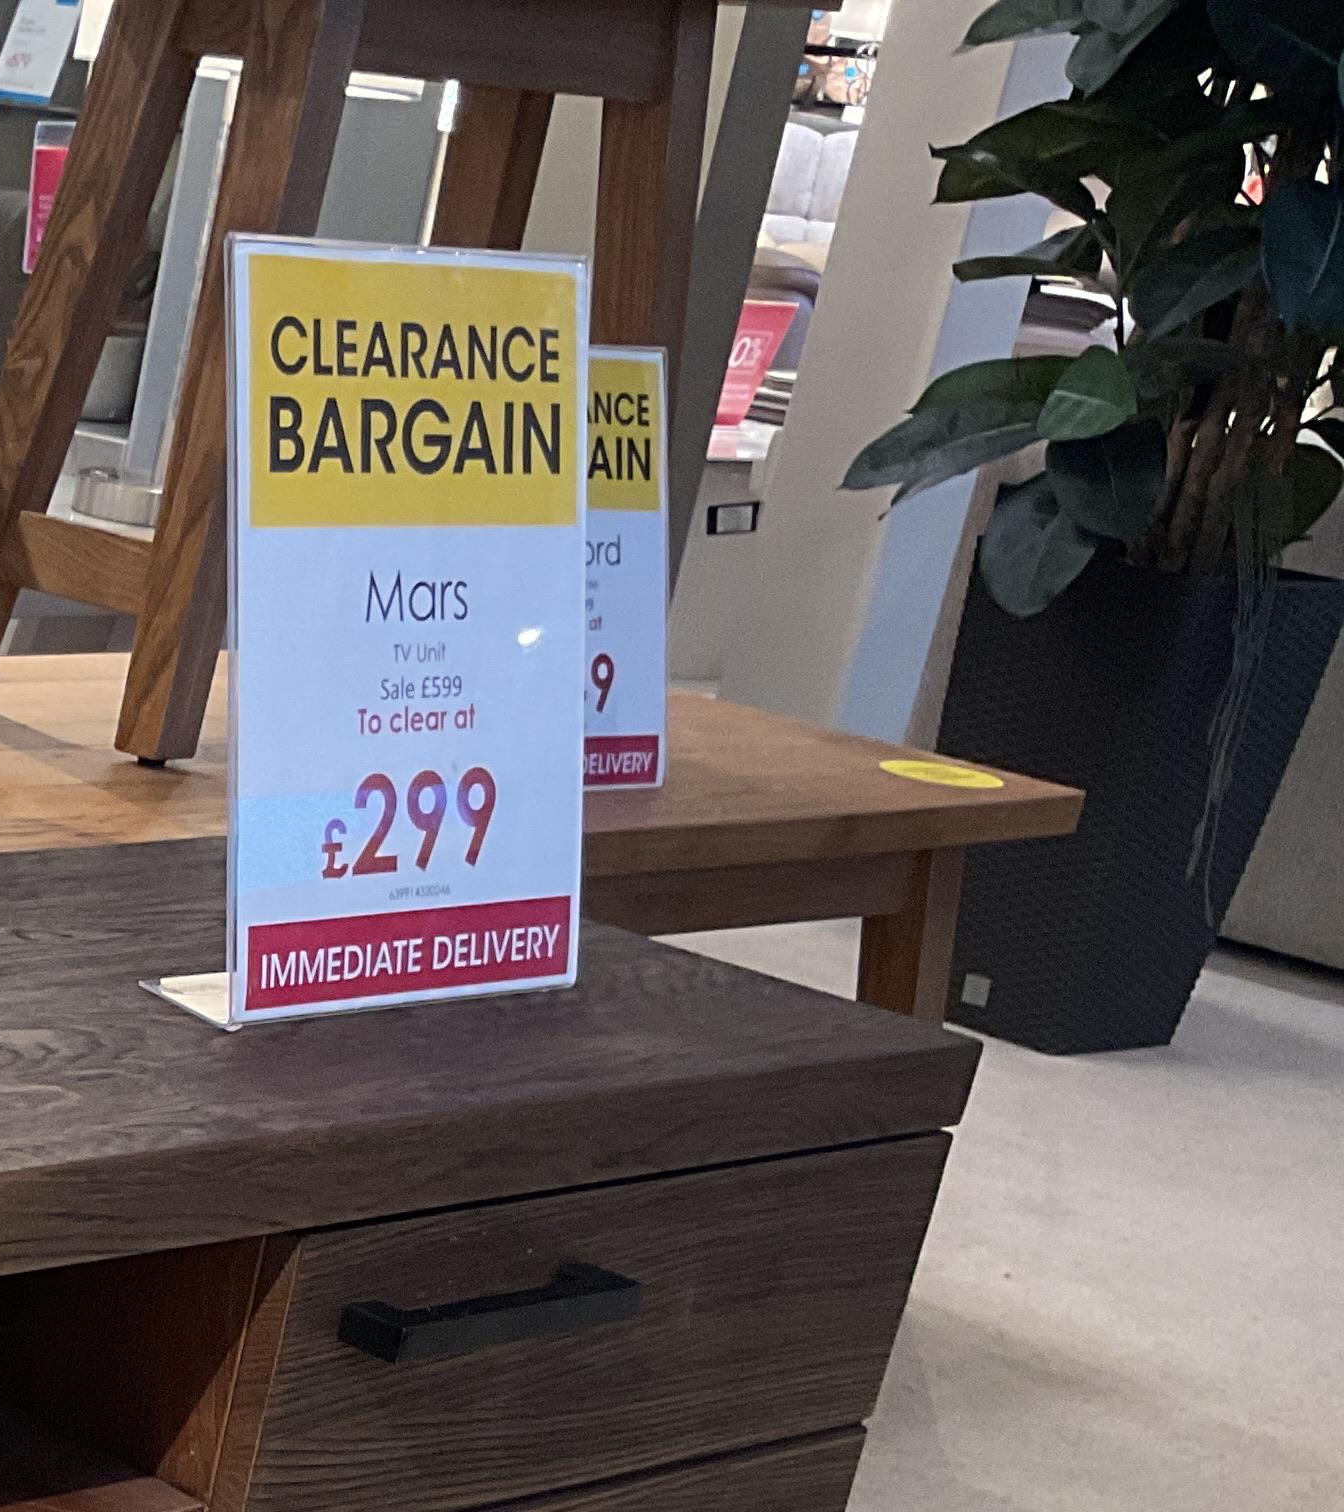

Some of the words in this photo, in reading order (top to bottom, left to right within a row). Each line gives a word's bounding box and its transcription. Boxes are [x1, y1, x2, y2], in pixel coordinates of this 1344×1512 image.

[270, 315, 560, 383] CLEARANCE
[587, 391, 650, 427] NCE
[269, 395, 561, 475] BARGAIN
[587, 436, 651, 481] AIN
[365, 569, 469, 623] Mars
[589, 615, 602, 631] at
[393, 643, 412, 662] TV
[416, 641, 446, 663] Unit
[380, 676, 415, 700] Sale
[421, 675, 463, 699] £599
[584, 652, 615, 713] 9
[357, 708, 382, 735] To
[389, 705, 448, 733] clear
[454, 703, 475, 730] at
[321, 766, 497, 880] £299
[260, 937, 423, 991] IMMEDIATE
[431, 924, 561, 971] DELIVERY
